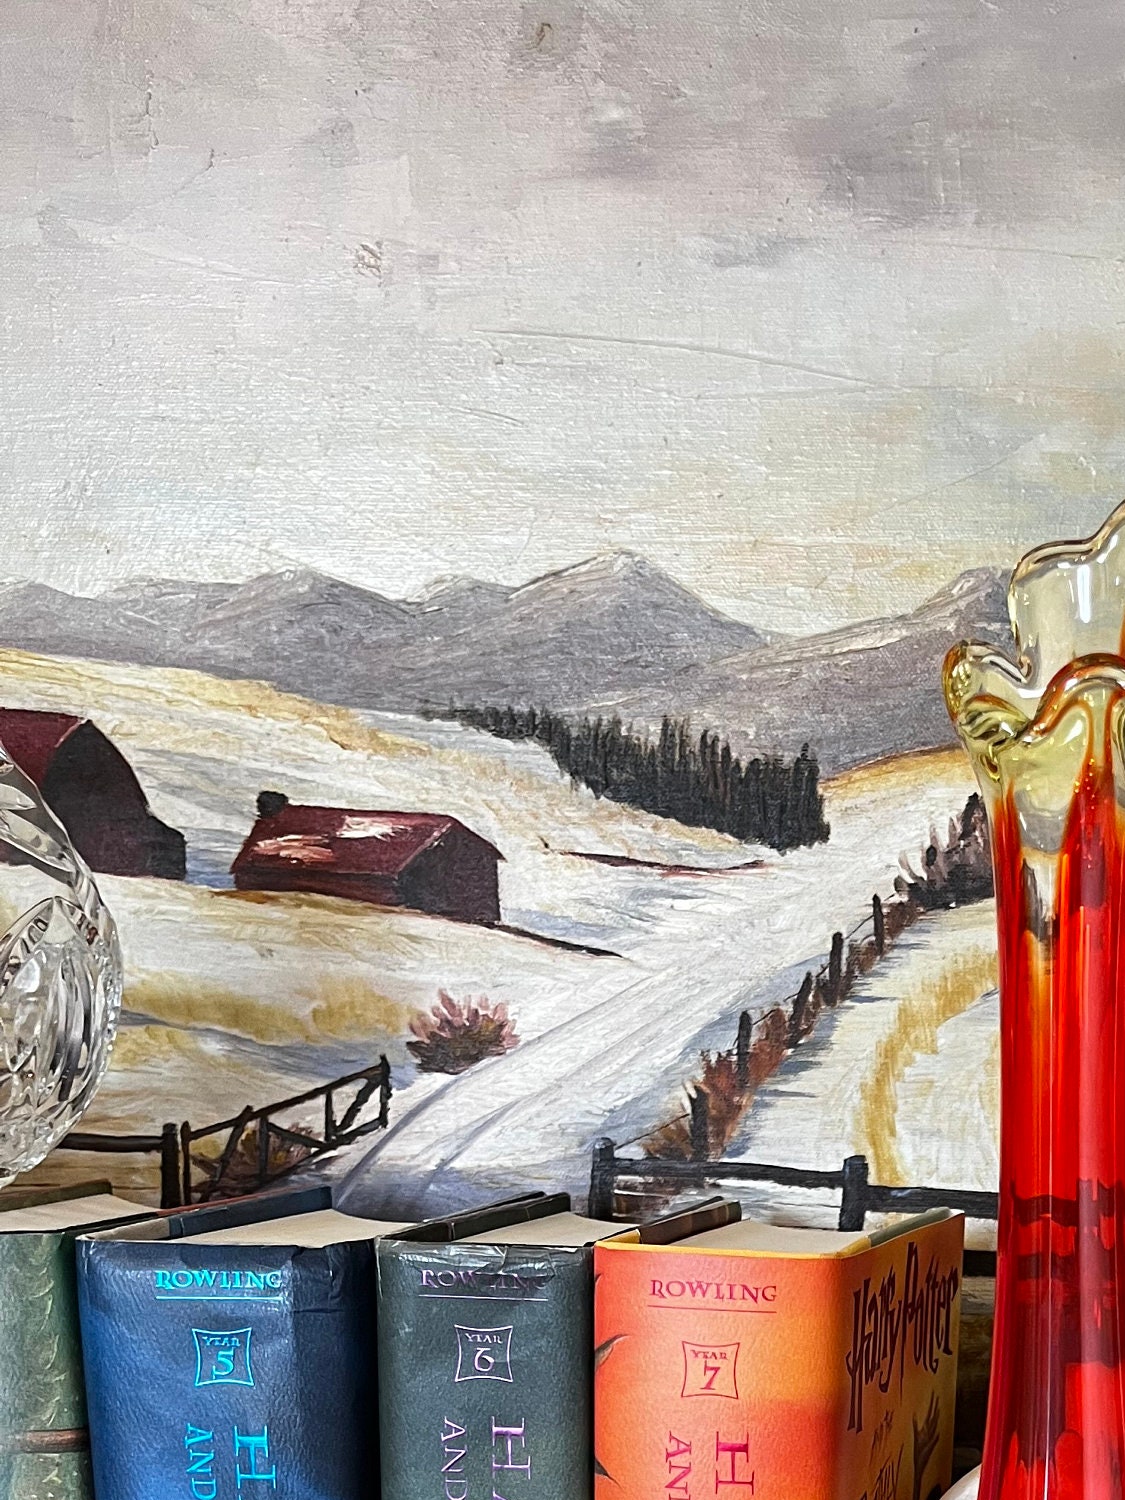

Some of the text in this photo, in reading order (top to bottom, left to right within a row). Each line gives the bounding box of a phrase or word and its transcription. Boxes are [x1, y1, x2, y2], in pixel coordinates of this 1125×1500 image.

[155, 1269, 283, 1291] ROWLING
[650, 1279, 777, 1304] ROWLING
[202, 1336, 241, 1348] YEAR
[465, 1333, 503, 1344] YEAR
[212, 1346, 235, 1380] 5
[474, 1347, 495, 1372] 6
[691, 1349, 728, 1361] YEAR
[700, 1360, 721, 1391] 7
